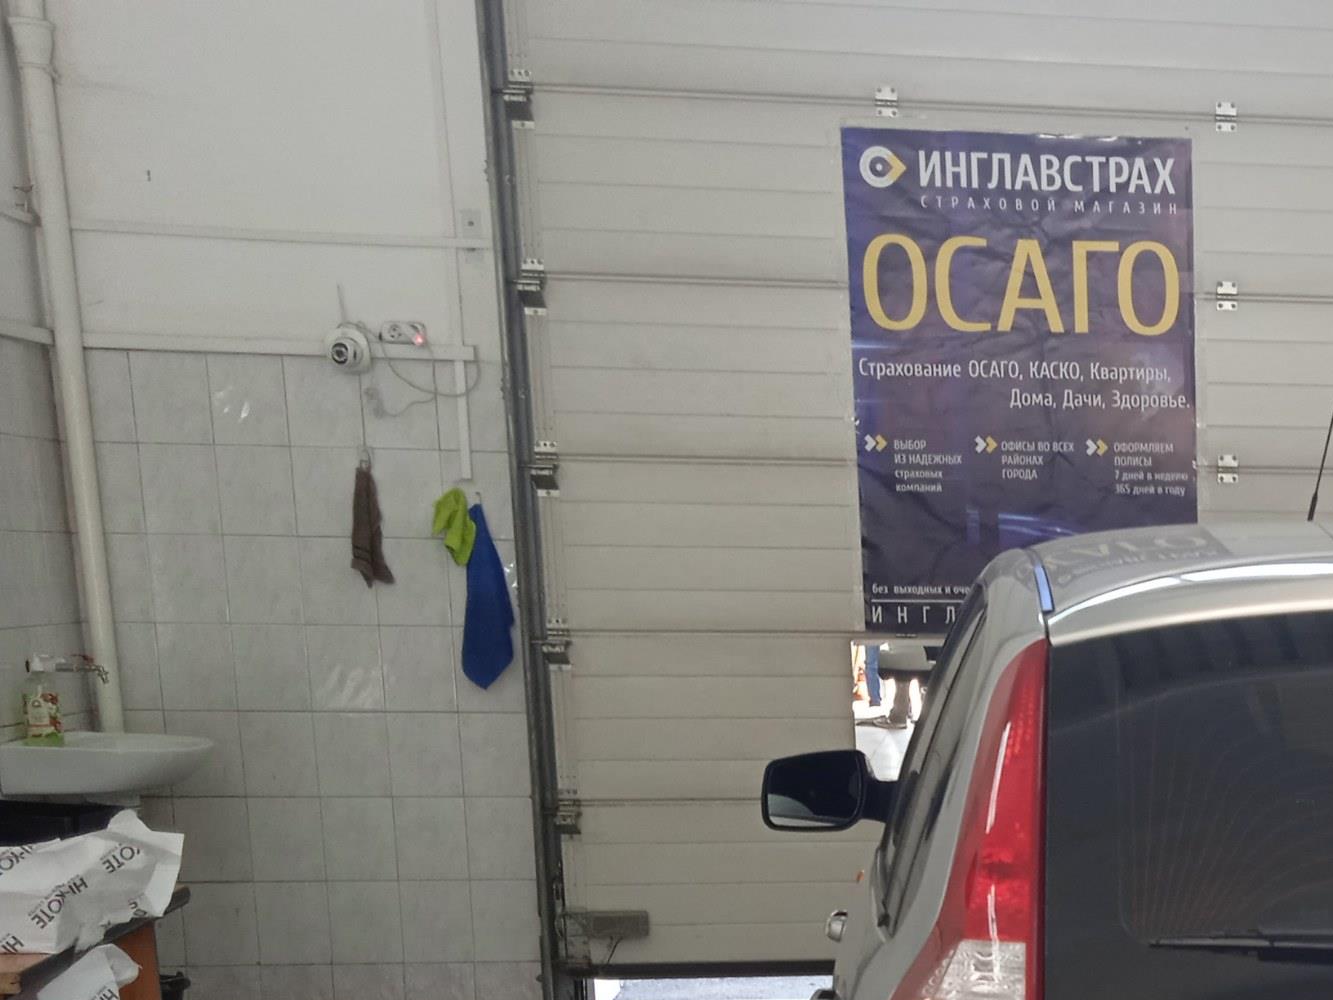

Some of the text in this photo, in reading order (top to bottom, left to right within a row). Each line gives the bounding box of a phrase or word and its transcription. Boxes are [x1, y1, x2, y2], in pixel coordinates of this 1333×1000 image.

[918, 150, 1176, 195] ИНГЛАВСТРАХ
[920, 195, 1177, 215] СТРАХОВОЙ МАГАЗИН
[862, 233, 1180, 336] ОСАГО
[859, 358, 1171, 384] Страхование ОСАГО, КАСКО, Квартиры,
[1010, 388, 1190, 411] Дома, Дачи, Здоровье.
[893, 440, 927, 451] ВЫБОР
[1001, 441, 1075, 452] ОФИСЫ ВО ВСЕХ
[1113, 442, 1174, 453] ОФОРМЛЯЕМ
[894, 453, 906, 464] ИЗ
[1002, 453, 1044, 466] РАЙОНАХ
[1114, 456, 1152, 467] ПОЛИСЫ
[1002, 468, 1038, 480] ГОРОДА
[896, 483, 943, 493] компаний
[872, 582, 889, 594] без
[894, 585, 943, 595] выходных
[953, 585, 971, 594] оче
[872, 605, 956, 624] ИНГЛ
[102, 843, 141, 874] OTE
